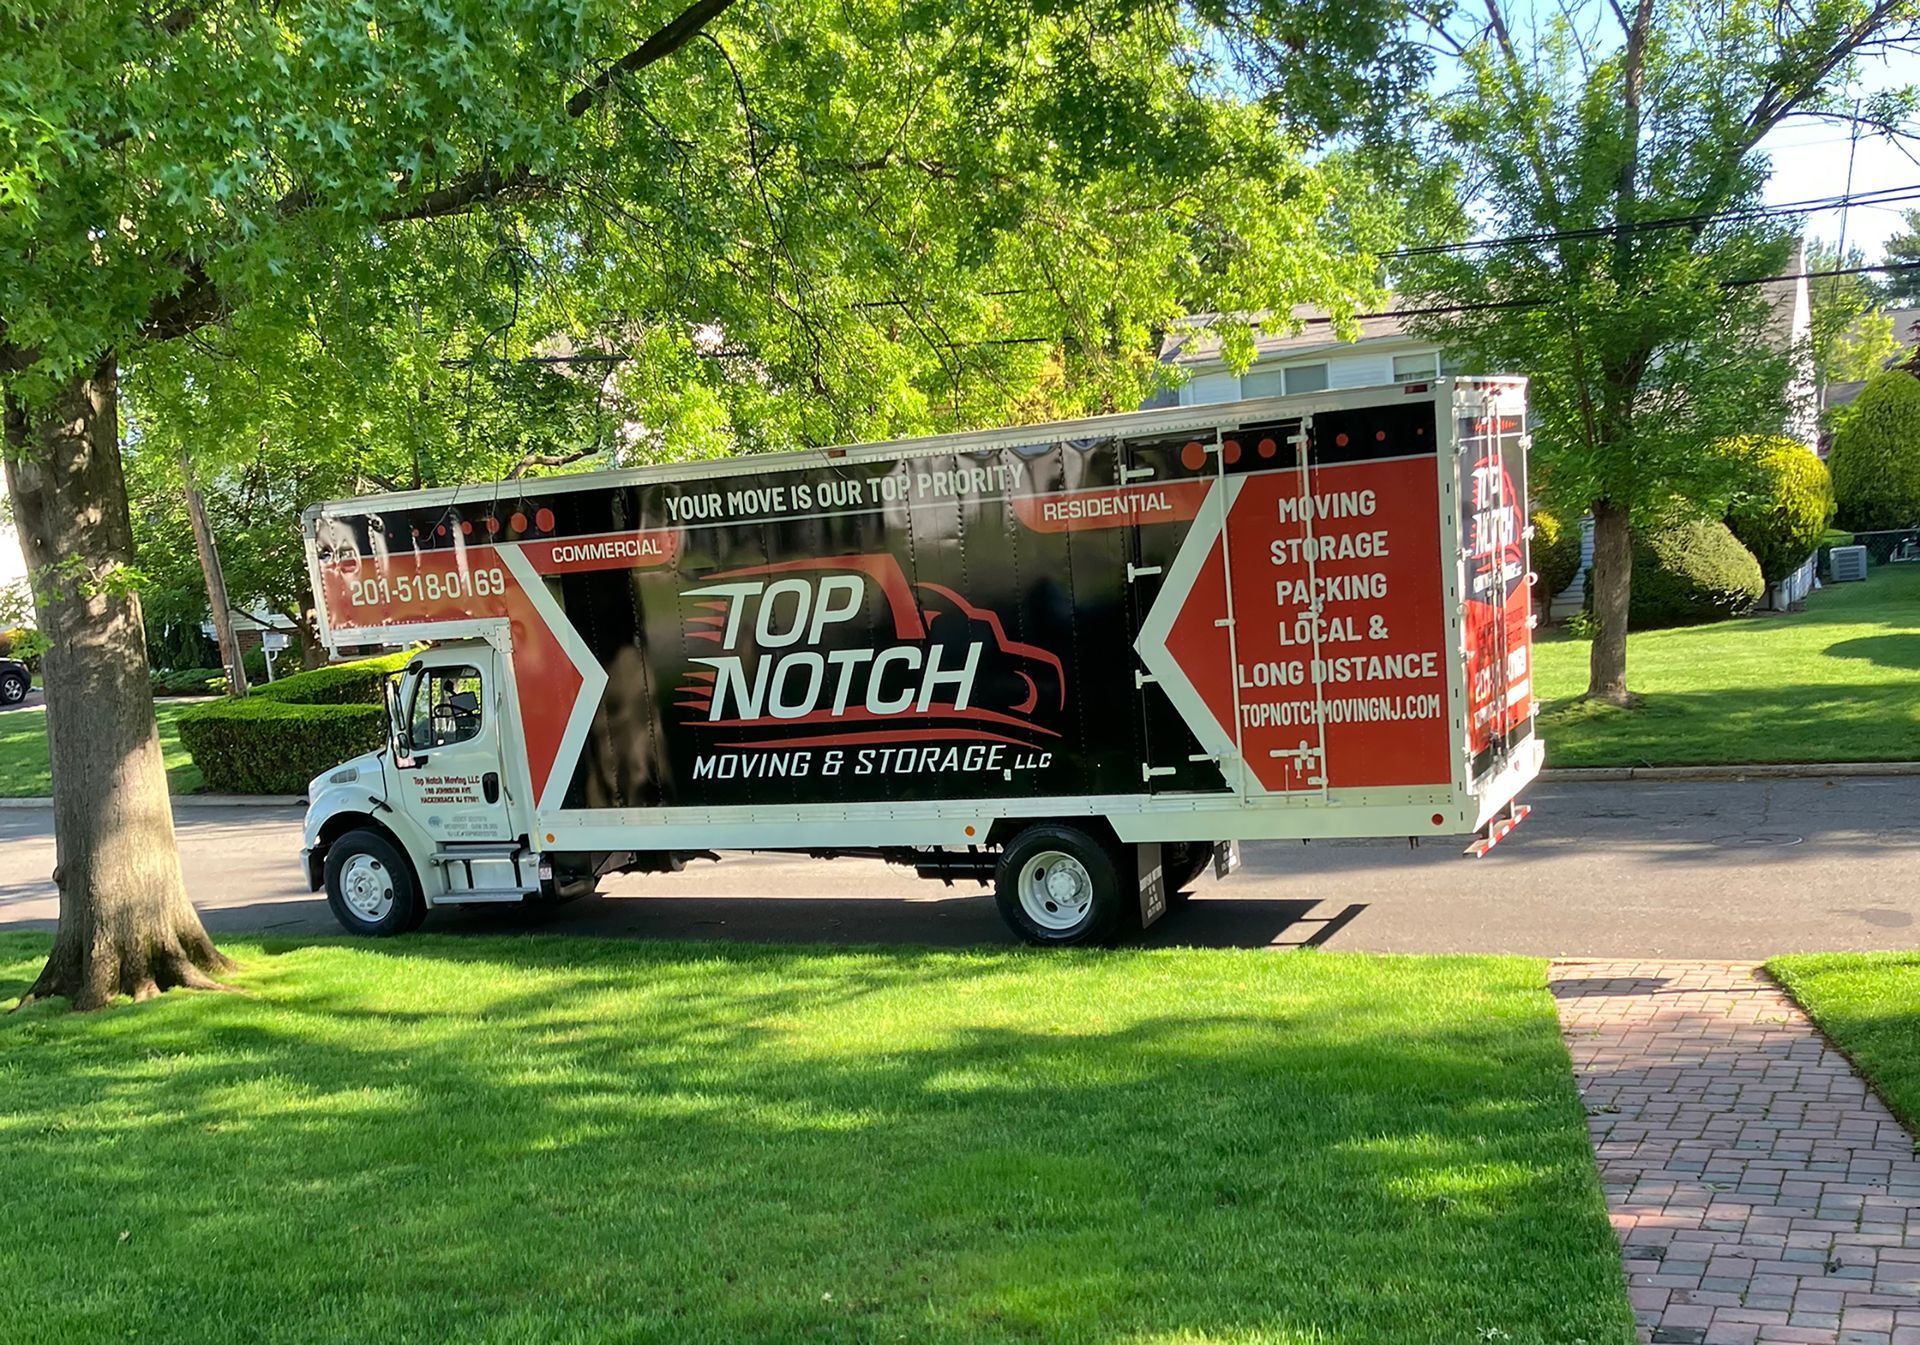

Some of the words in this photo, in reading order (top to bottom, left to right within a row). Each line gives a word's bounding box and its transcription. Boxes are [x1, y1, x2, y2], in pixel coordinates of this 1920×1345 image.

[666, 495, 724, 521] YOUR
[727, 486, 787, 516] MOVE
[791, 485, 813, 510] IS
[817, 480, 864, 509] OUR
[867, 475, 911, 503] TOP
[917, 463, 1025, 498] PRIORITY
[1043, 491, 1172, 521] RESIDENTIAL
[1278, 489, 1377, 524] MOVING
[551, 537, 662, 564] COMMERCIAL
[1270, 530, 1389, 566] STORAGE
[351, 567, 506, 607] 201-518-0169
[1276, 572, 1388, 606] PACKING
[679, 574, 865, 651] TOP
[1279, 615, 1362, 646] LOCAL
[1368, 614, 1389, 640] &
[687, 641, 984, 722] NOTCH
[1238, 660, 1304, 689] LONG
[1311, 652, 1438, 685] DISTANCE
[1241, 693, 1441, 728] TOPNOTCHMOVINGNJ.COM
[468, 775, 480, 784] LLC
[692, 750, 812, 780] MOVING
[821, 750, 845, 776] &
[854, 744, 1007, 776] STORAGE
[1014, 752, 1053, 770] LLC
